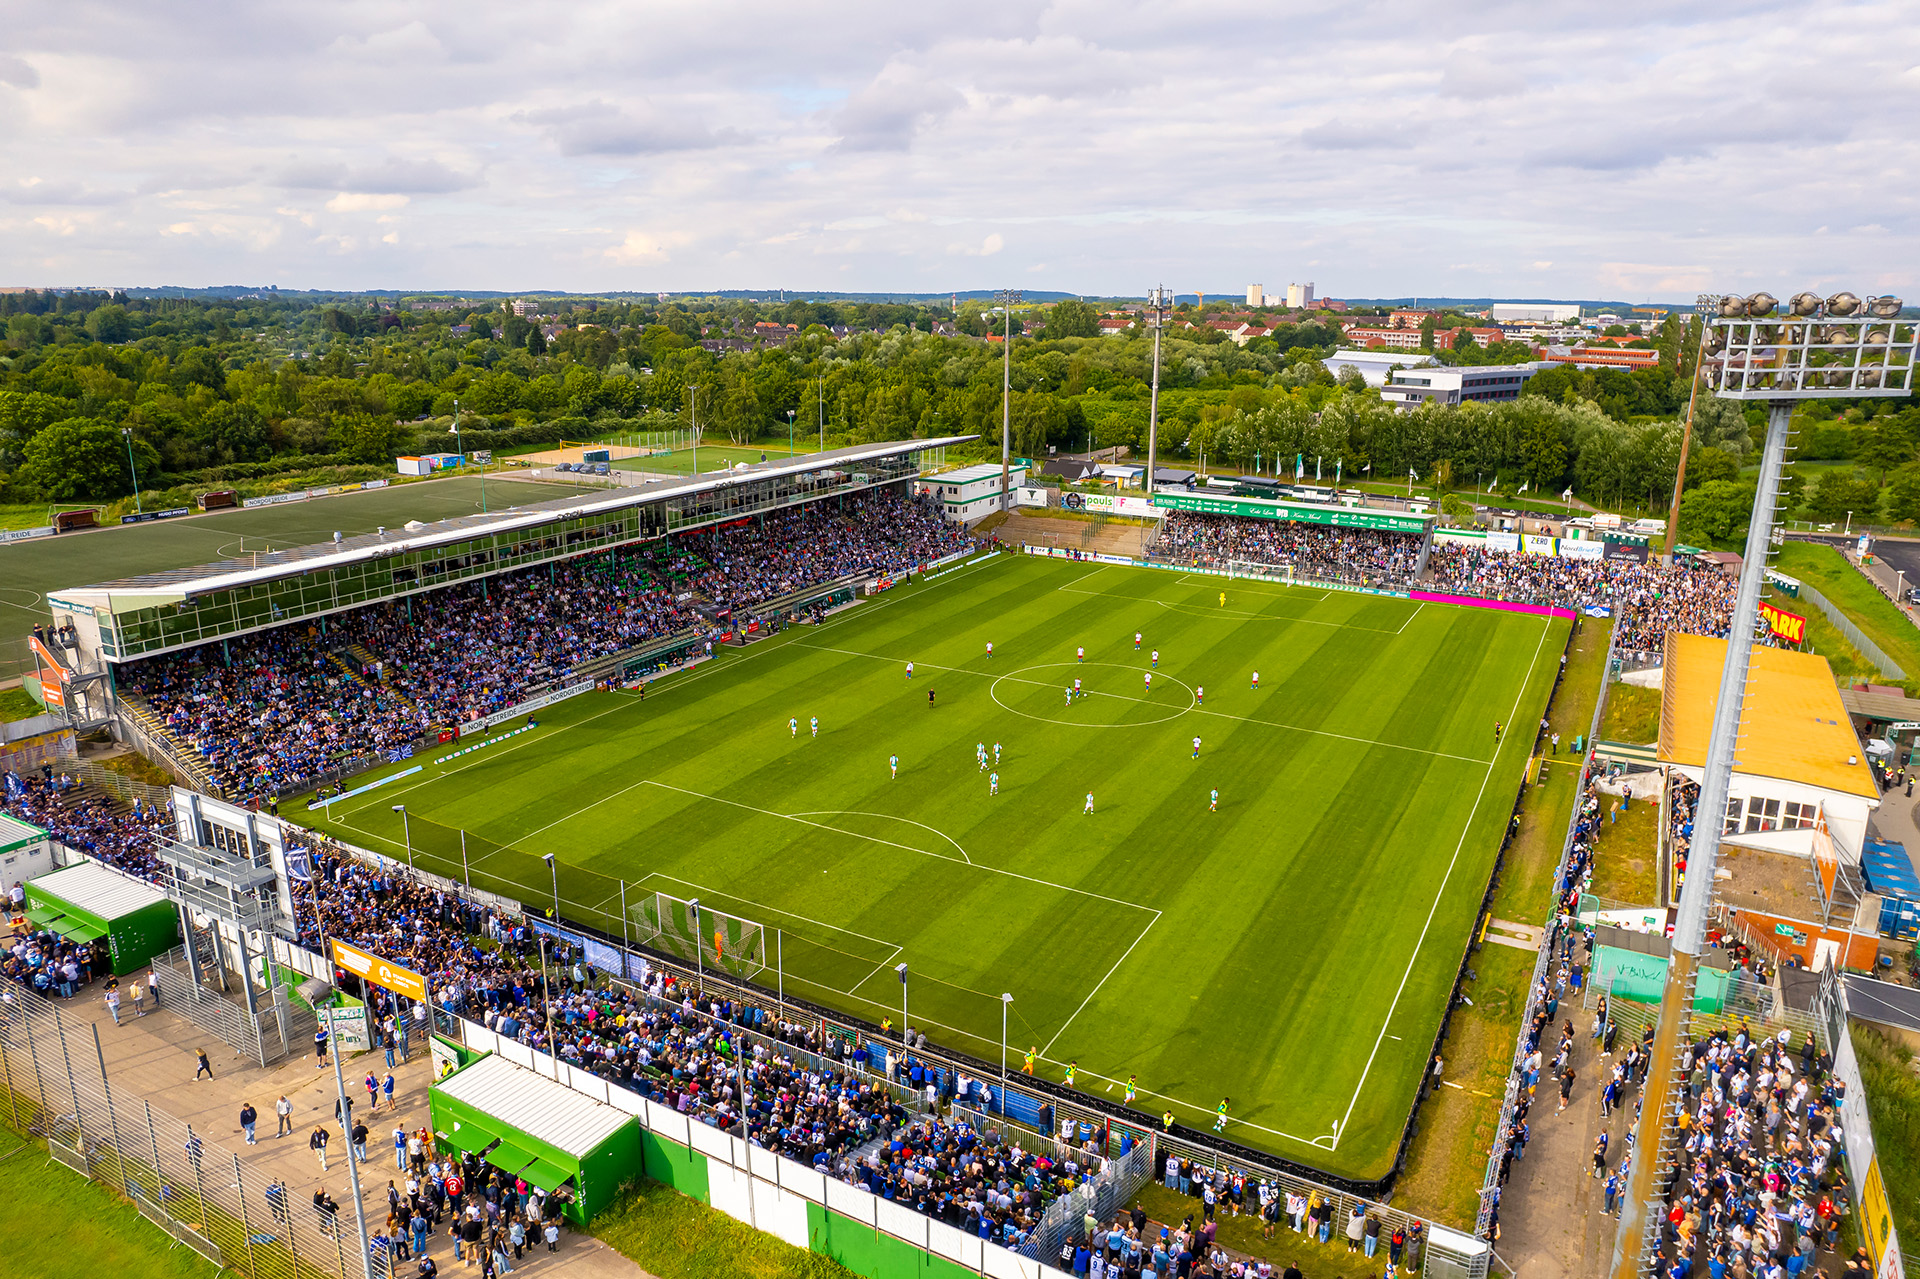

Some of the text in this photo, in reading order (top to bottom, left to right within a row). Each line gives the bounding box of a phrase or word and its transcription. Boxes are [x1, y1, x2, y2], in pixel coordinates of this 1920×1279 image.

[1086, 496, 1113, 506] pauls
[1560, 544, 1596, 553] NordBrief
[1762, 606, 1803, 641] PARK
[550, 679, 594, 702] NORDGETREIDE
[467, 707, 518, 731] NORGETREIDE
[1092, 1260, 1098, 1269] 9
